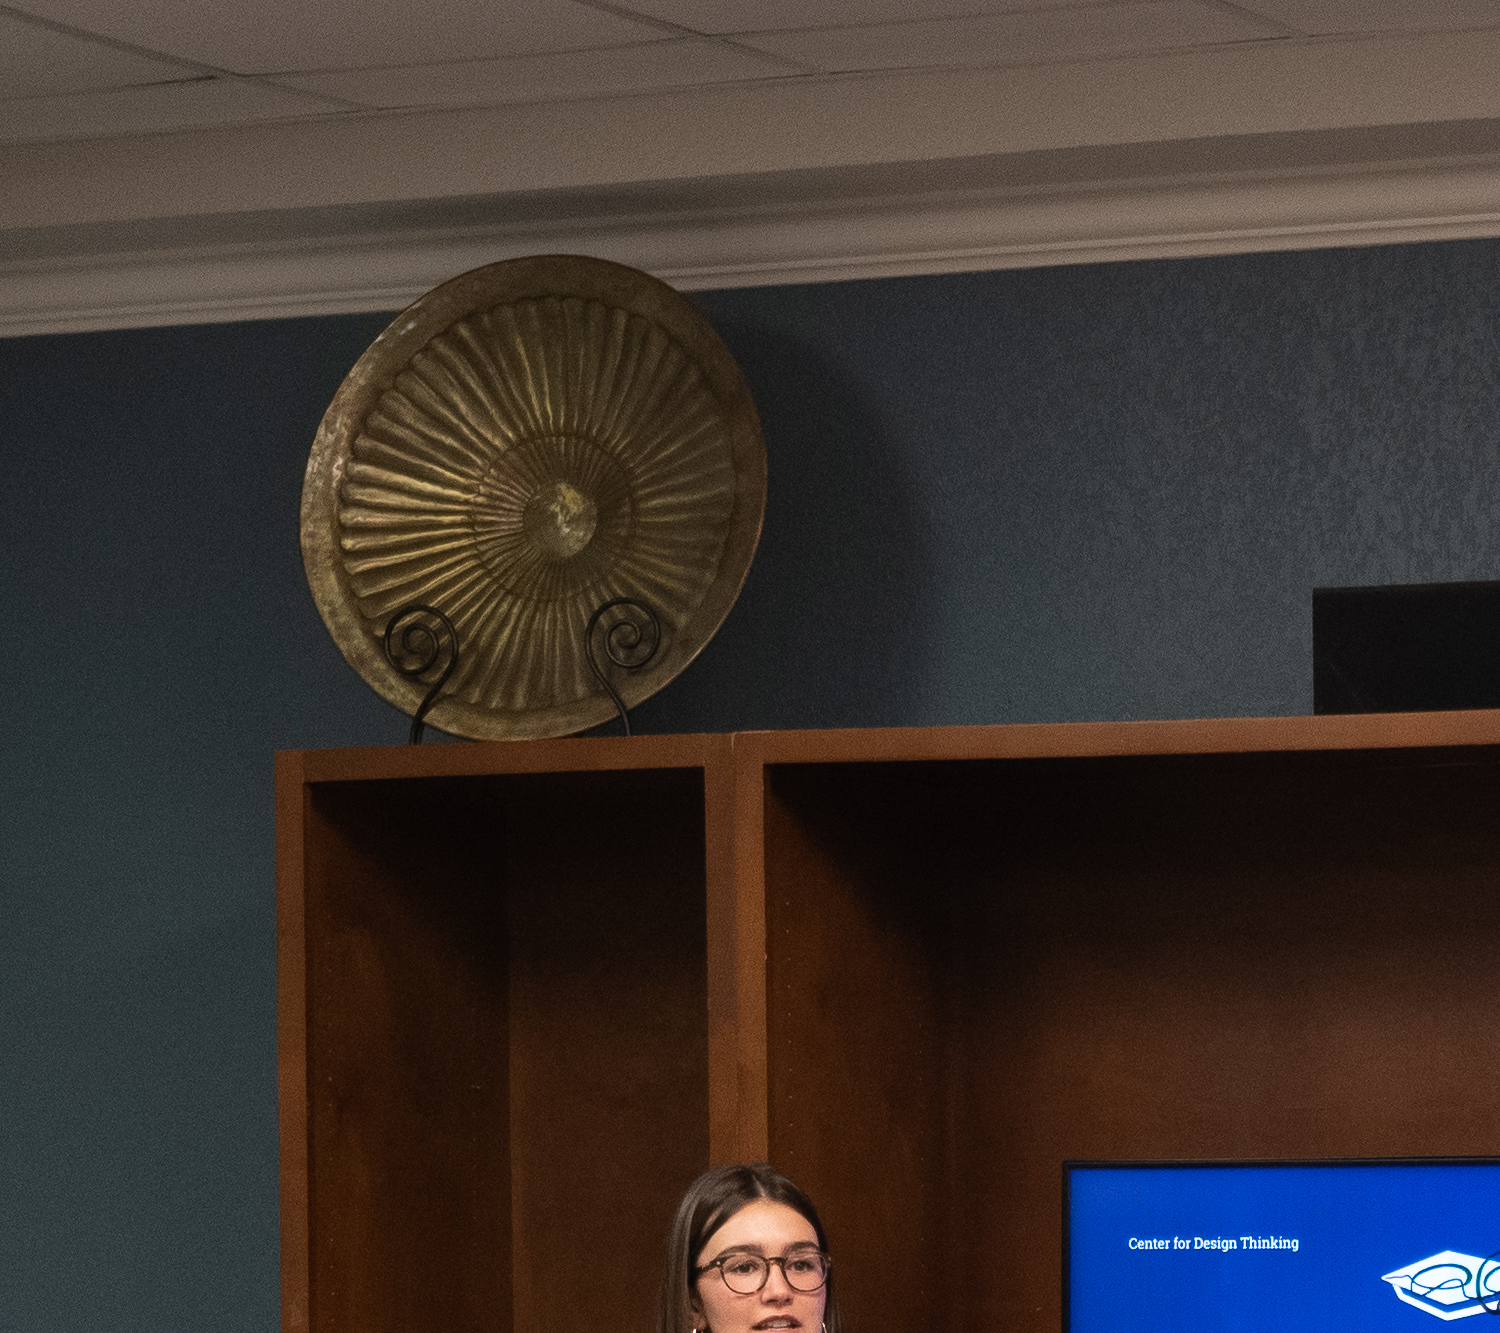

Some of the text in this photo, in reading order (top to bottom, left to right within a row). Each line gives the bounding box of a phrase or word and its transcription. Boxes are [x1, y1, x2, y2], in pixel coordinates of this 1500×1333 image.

[1128, 1235, 1299, 1253] Center for Design Thinking
